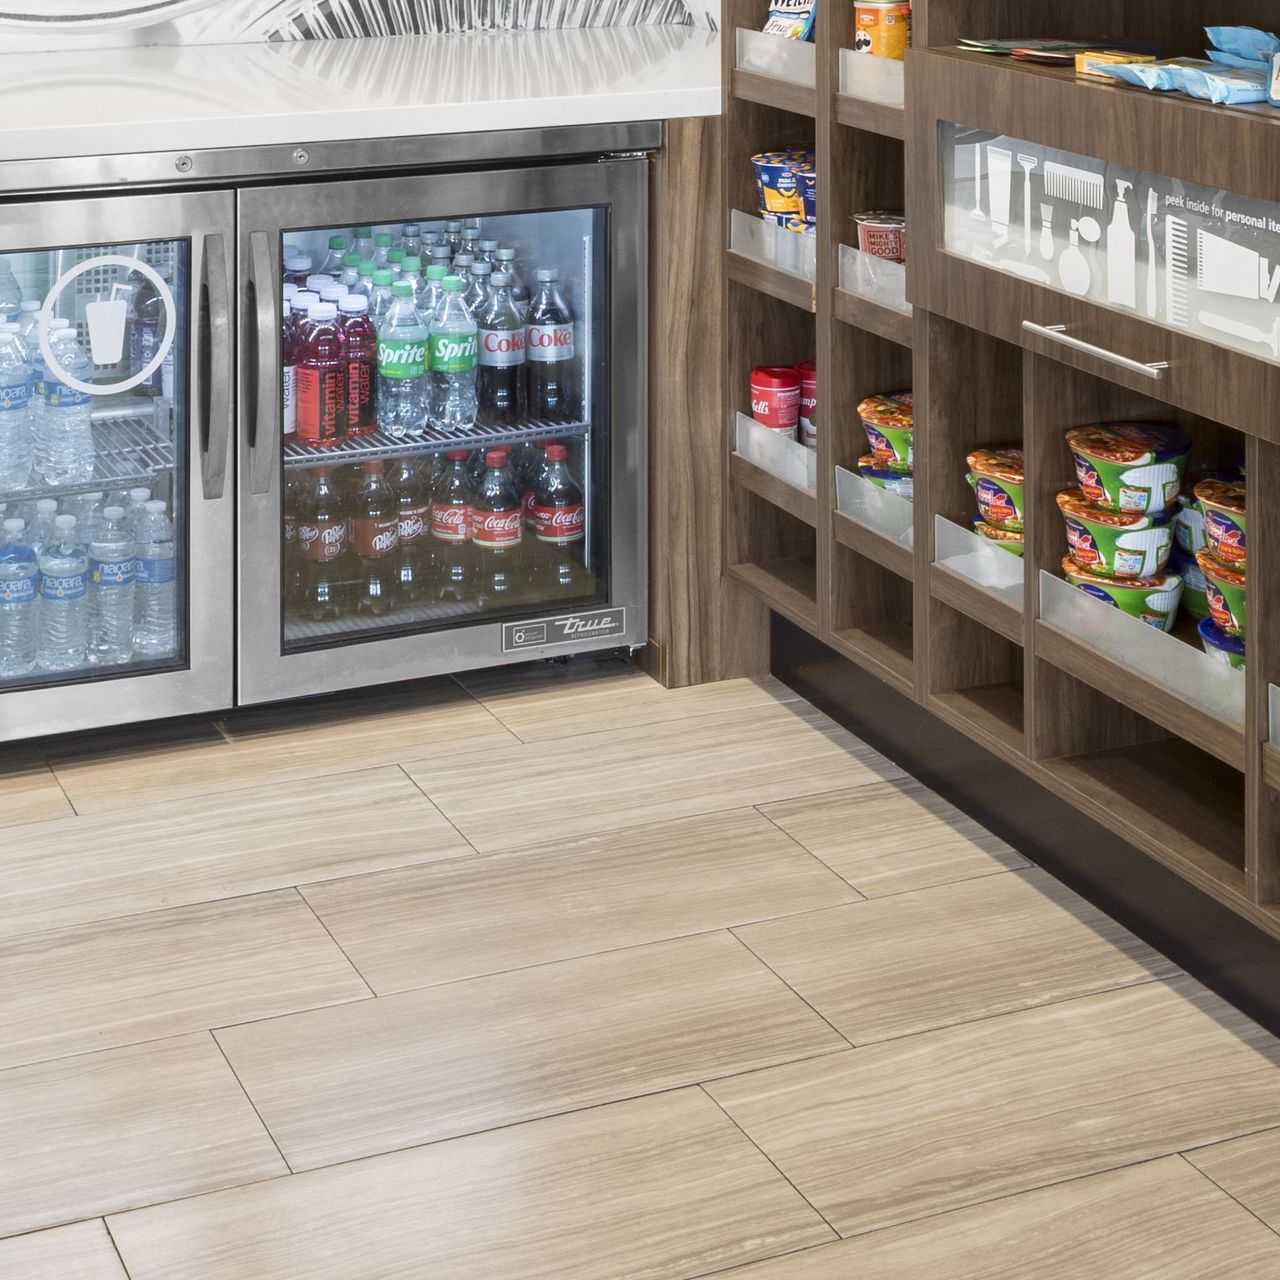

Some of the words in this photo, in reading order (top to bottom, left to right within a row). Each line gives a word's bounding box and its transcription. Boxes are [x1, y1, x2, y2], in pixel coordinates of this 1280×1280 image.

[1165, 195, 1185, 208] peek
[1186, 198, 1210, 215] inside
[1211, 204, 1225, 218] for
[1225, 210, 1266, 229] personal
[870, 231, 897, 240] MIKE'S
[871, 247, 898, 255] GOOD
[528, 327, 571, 348] Coke
[378, 343, 424, 364] Sprite
[336, 372, 344, 413] water
[348, 363, 359, 424] vitamin
[360, 363, 370, 404] water
[323, 373, 336, 436] vitamin
[555, 617, 616, 634] true
